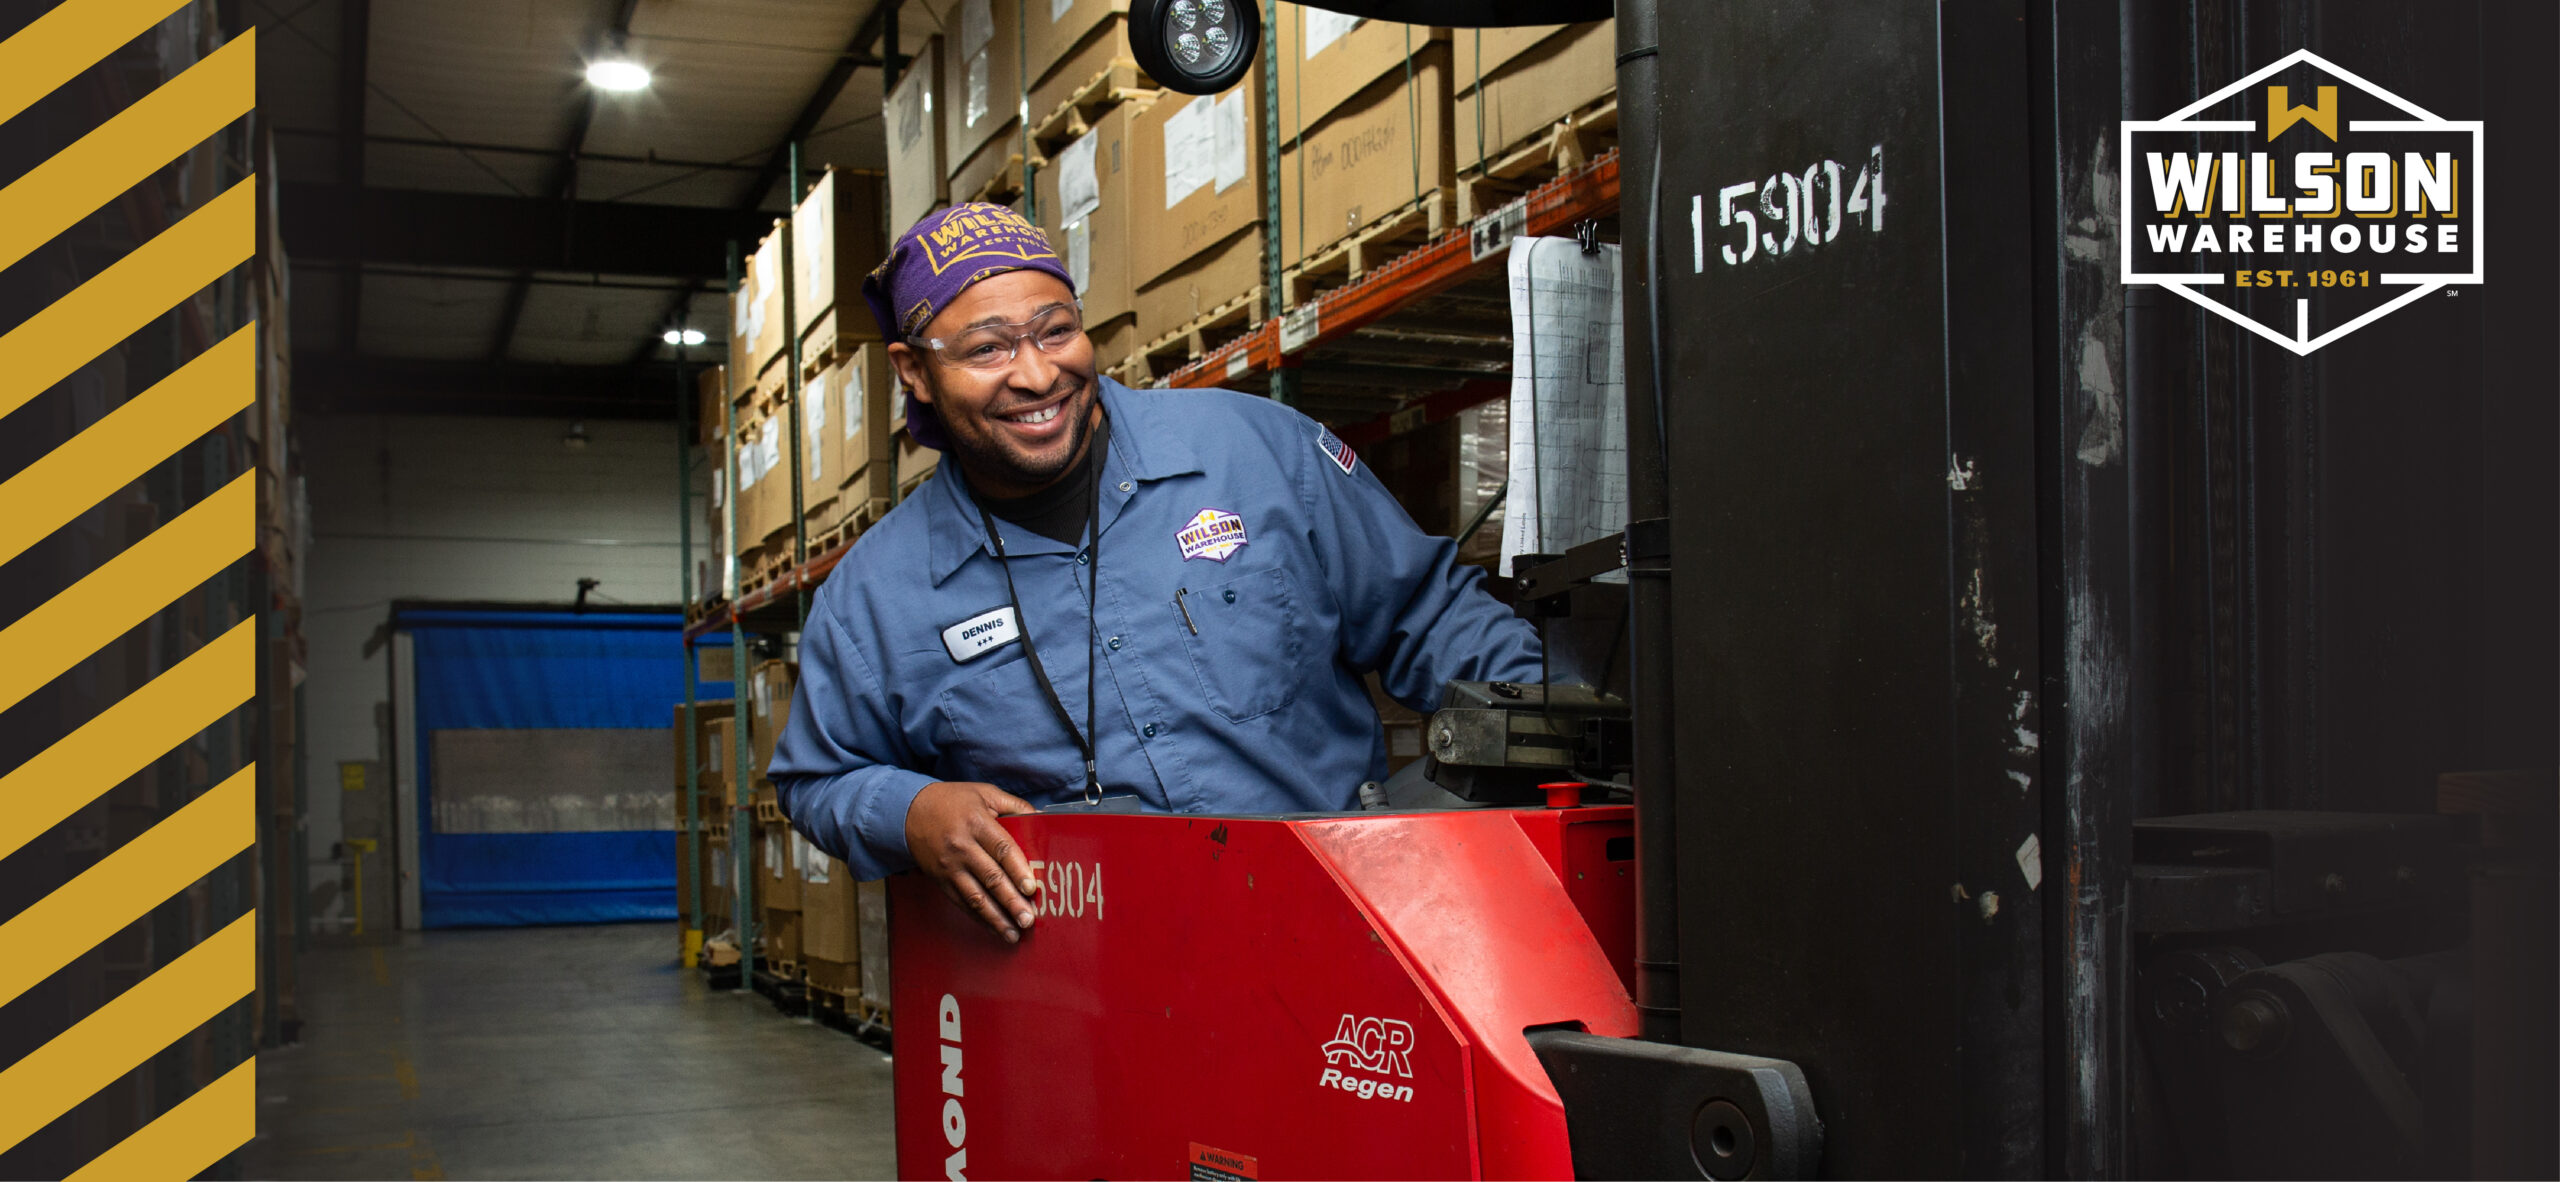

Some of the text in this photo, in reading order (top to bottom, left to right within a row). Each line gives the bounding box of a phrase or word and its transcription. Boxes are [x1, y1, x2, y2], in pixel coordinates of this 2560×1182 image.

[1691, 145, 1886, 273] 15904
[1180, 519, 1242, 547] WILSON
[1185, 532, 1245, 554] WAREHOUSE
[962, 618, 1005, 641] DENNIS
[1322, 1013, 1414, 1078] ACR
[1319, 1067, 1414, 1102] Regen
[1207, 1152, 1244, 1171] WARNING
